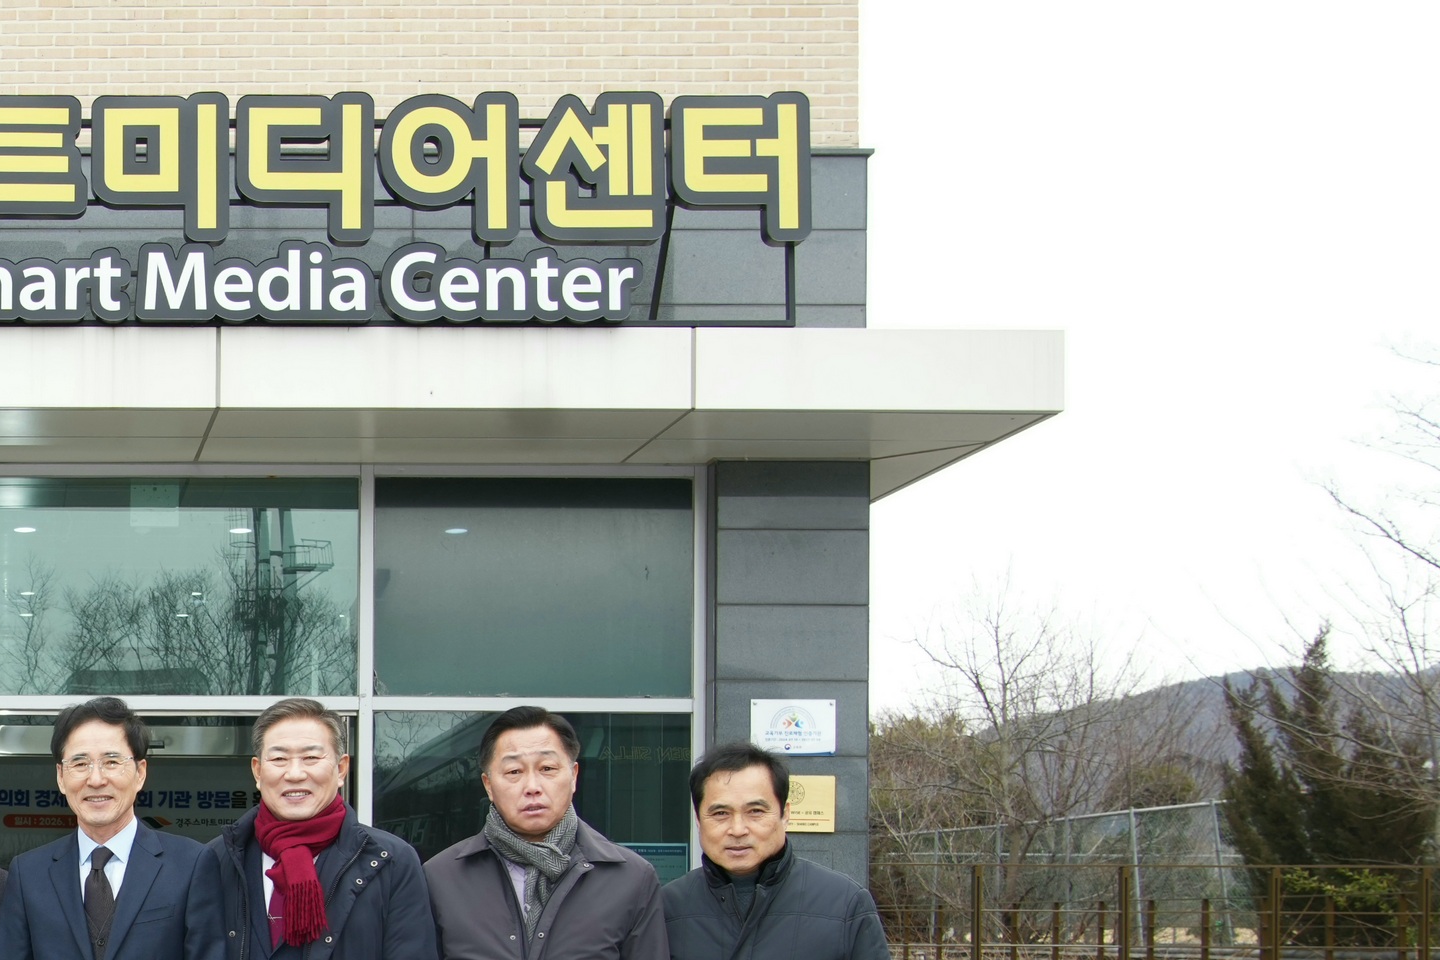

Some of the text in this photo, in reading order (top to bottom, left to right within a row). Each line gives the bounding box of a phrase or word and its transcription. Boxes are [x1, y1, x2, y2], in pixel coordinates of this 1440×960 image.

[144, 249, 365, 314] Media
[389, 249, 634, 314] Center
[158, 790, 192, 809] 기관
[197, 790, 247, 809] 방문을
[14, 816, 32, 826] 일시
